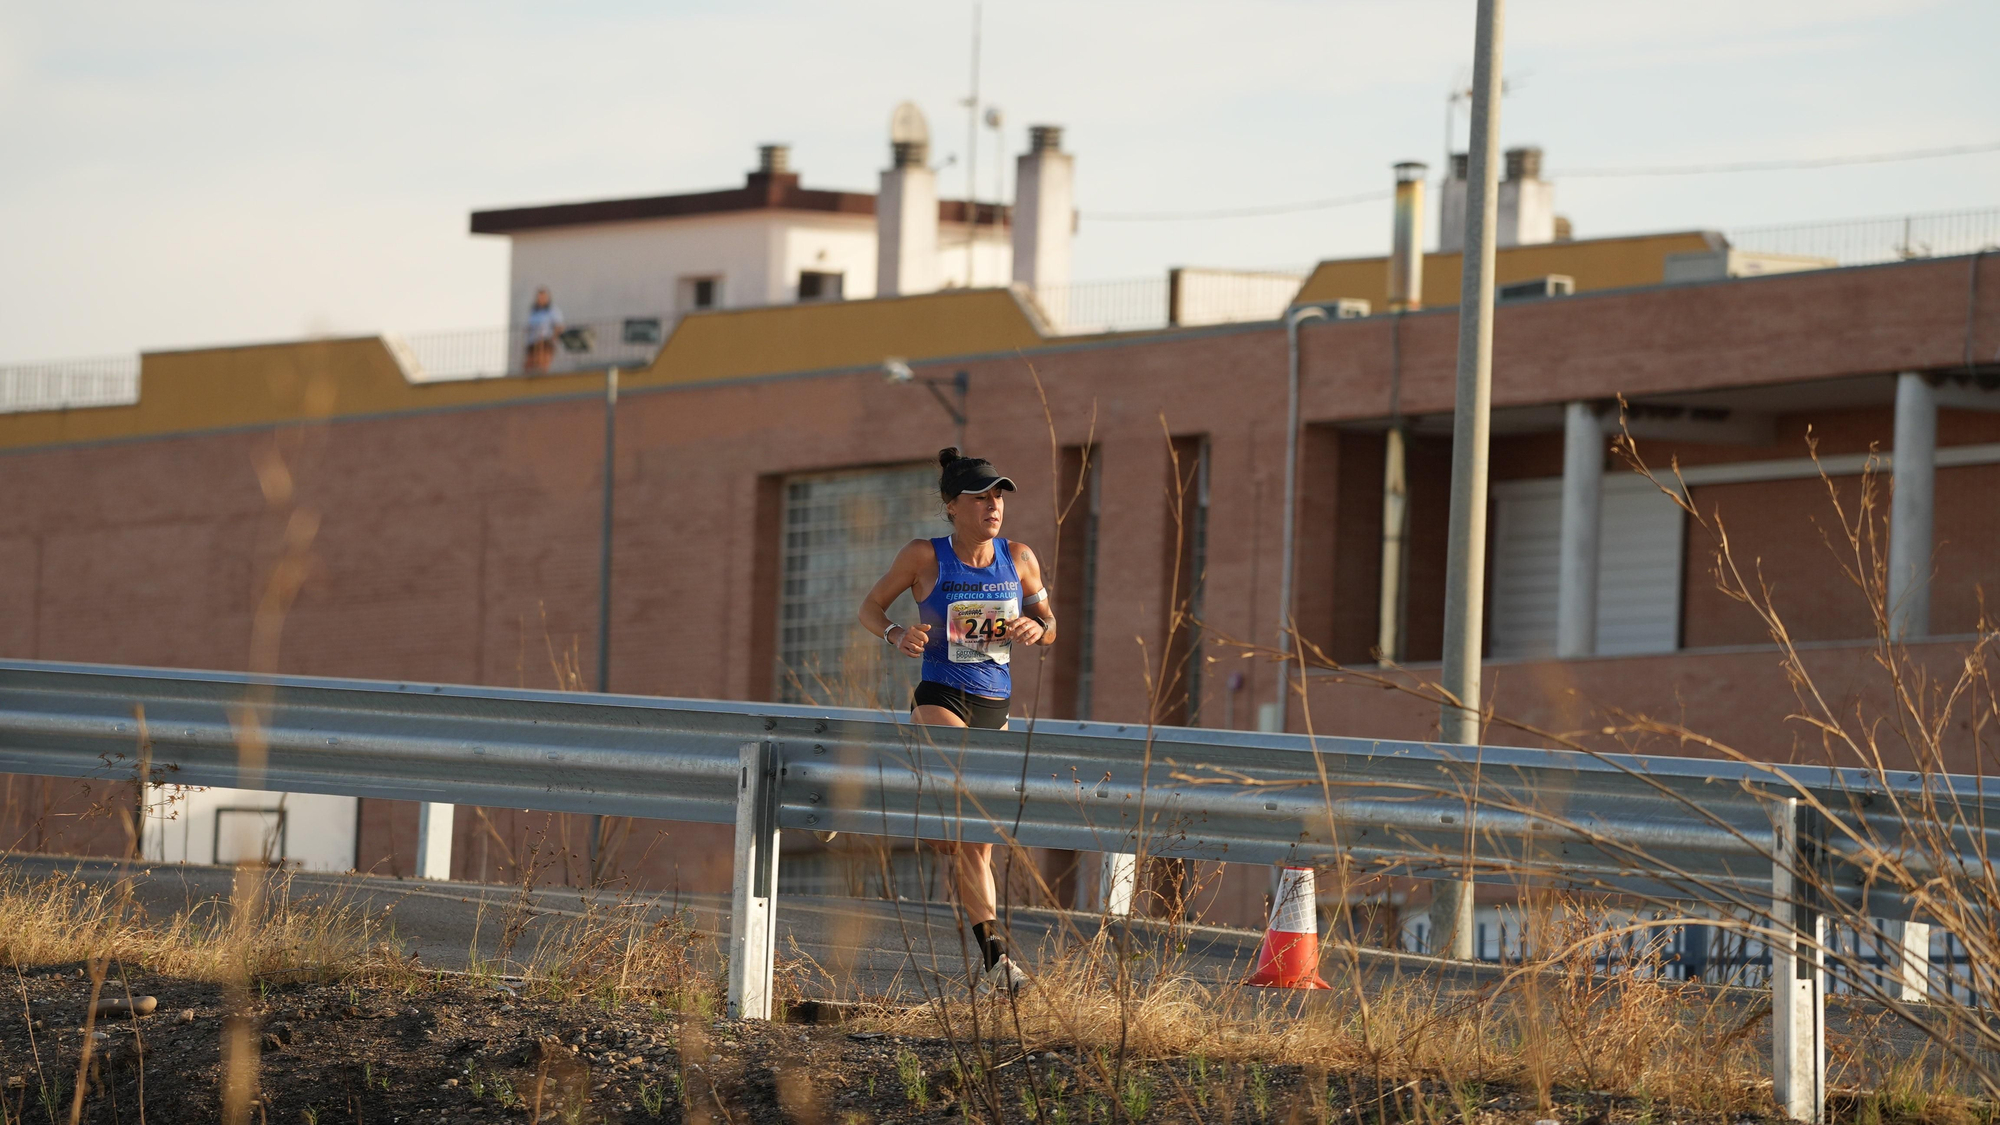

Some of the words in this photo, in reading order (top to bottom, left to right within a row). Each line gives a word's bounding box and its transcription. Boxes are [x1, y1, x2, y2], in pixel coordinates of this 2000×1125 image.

[942, 581, 1018, 592] Globalcenter
[946, 592, 984, 600] EJERCICIO
[965, 618, 1007, 639] 243
